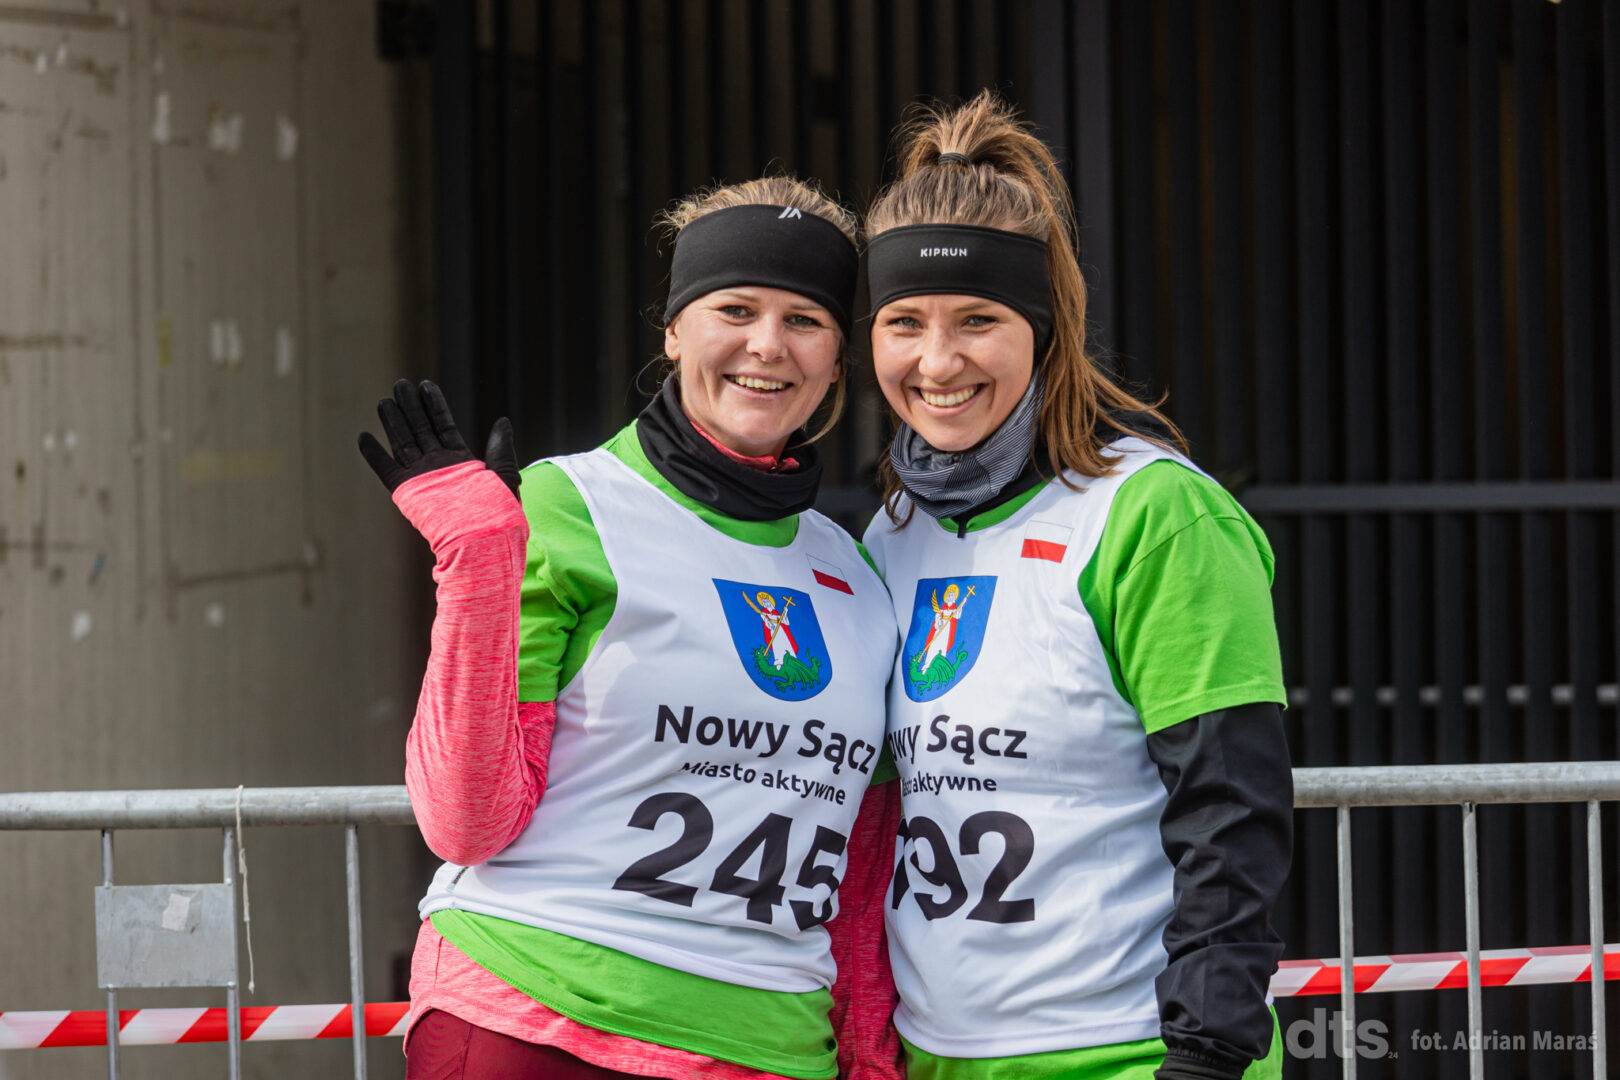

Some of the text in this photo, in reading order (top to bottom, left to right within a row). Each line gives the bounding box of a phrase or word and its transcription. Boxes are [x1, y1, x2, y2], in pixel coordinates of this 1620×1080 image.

[920, 247, 968, 258] KIPRUN
[654, 704, 876, 775] Nowy Sącz
[887, 714, 1028, 766] owy Sącz
[680, 761, 846, 806] Miasto aktywne
[913, 770, 997, 796] aktywne
[611, 791, 848, 932] 245
